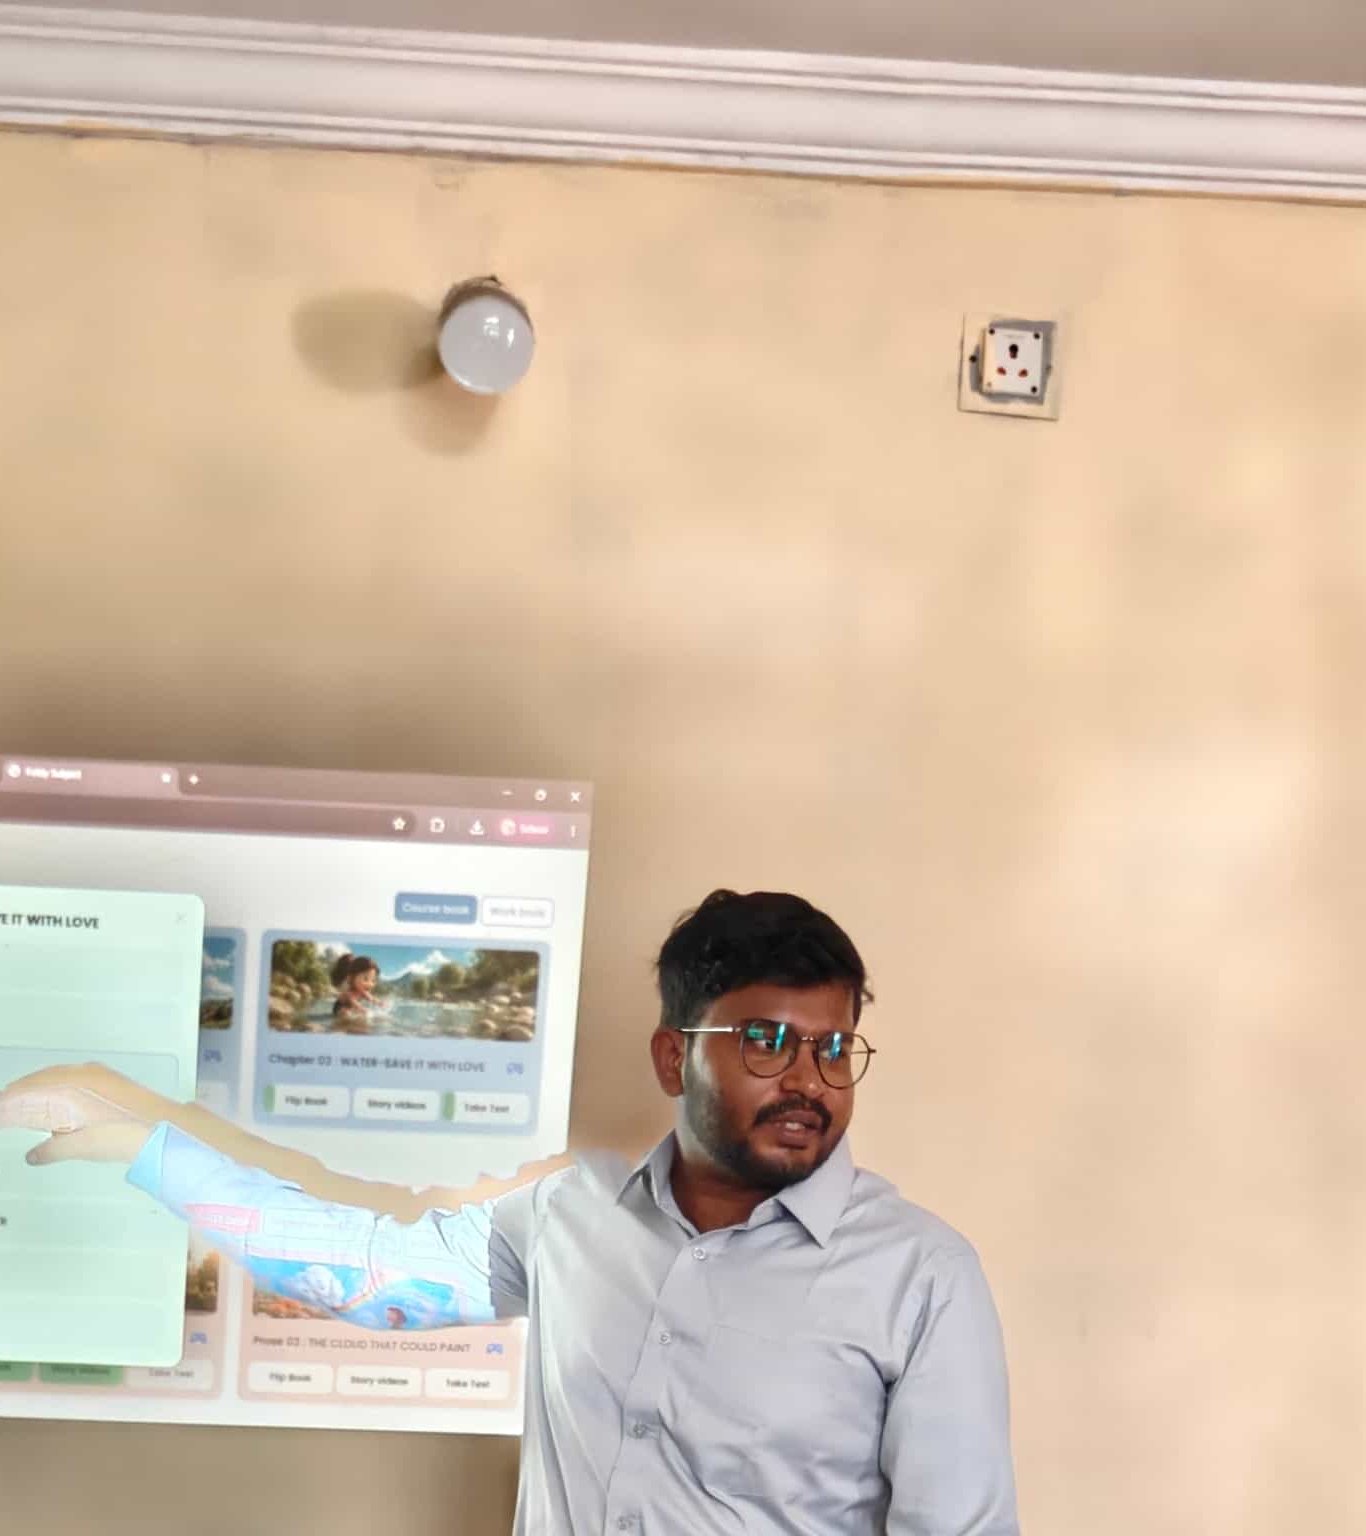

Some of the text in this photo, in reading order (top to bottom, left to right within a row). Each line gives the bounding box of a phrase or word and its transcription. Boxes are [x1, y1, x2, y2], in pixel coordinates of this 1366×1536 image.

[11, 914, 23, 926] IT
[26, 914, 63, 928] WITH
[65, 916, 100, 930] LOVE
[457, 1062, 485, 1073] LOVE
[308, 1337, 327, 1349] THE
[329, 1338, 368, 1350] CLOUD
[370, 1340, 398, 1351] THAT
[399, 1341, 437, 1353] COULD
[439, 1342, 471, 1353] PAINT
